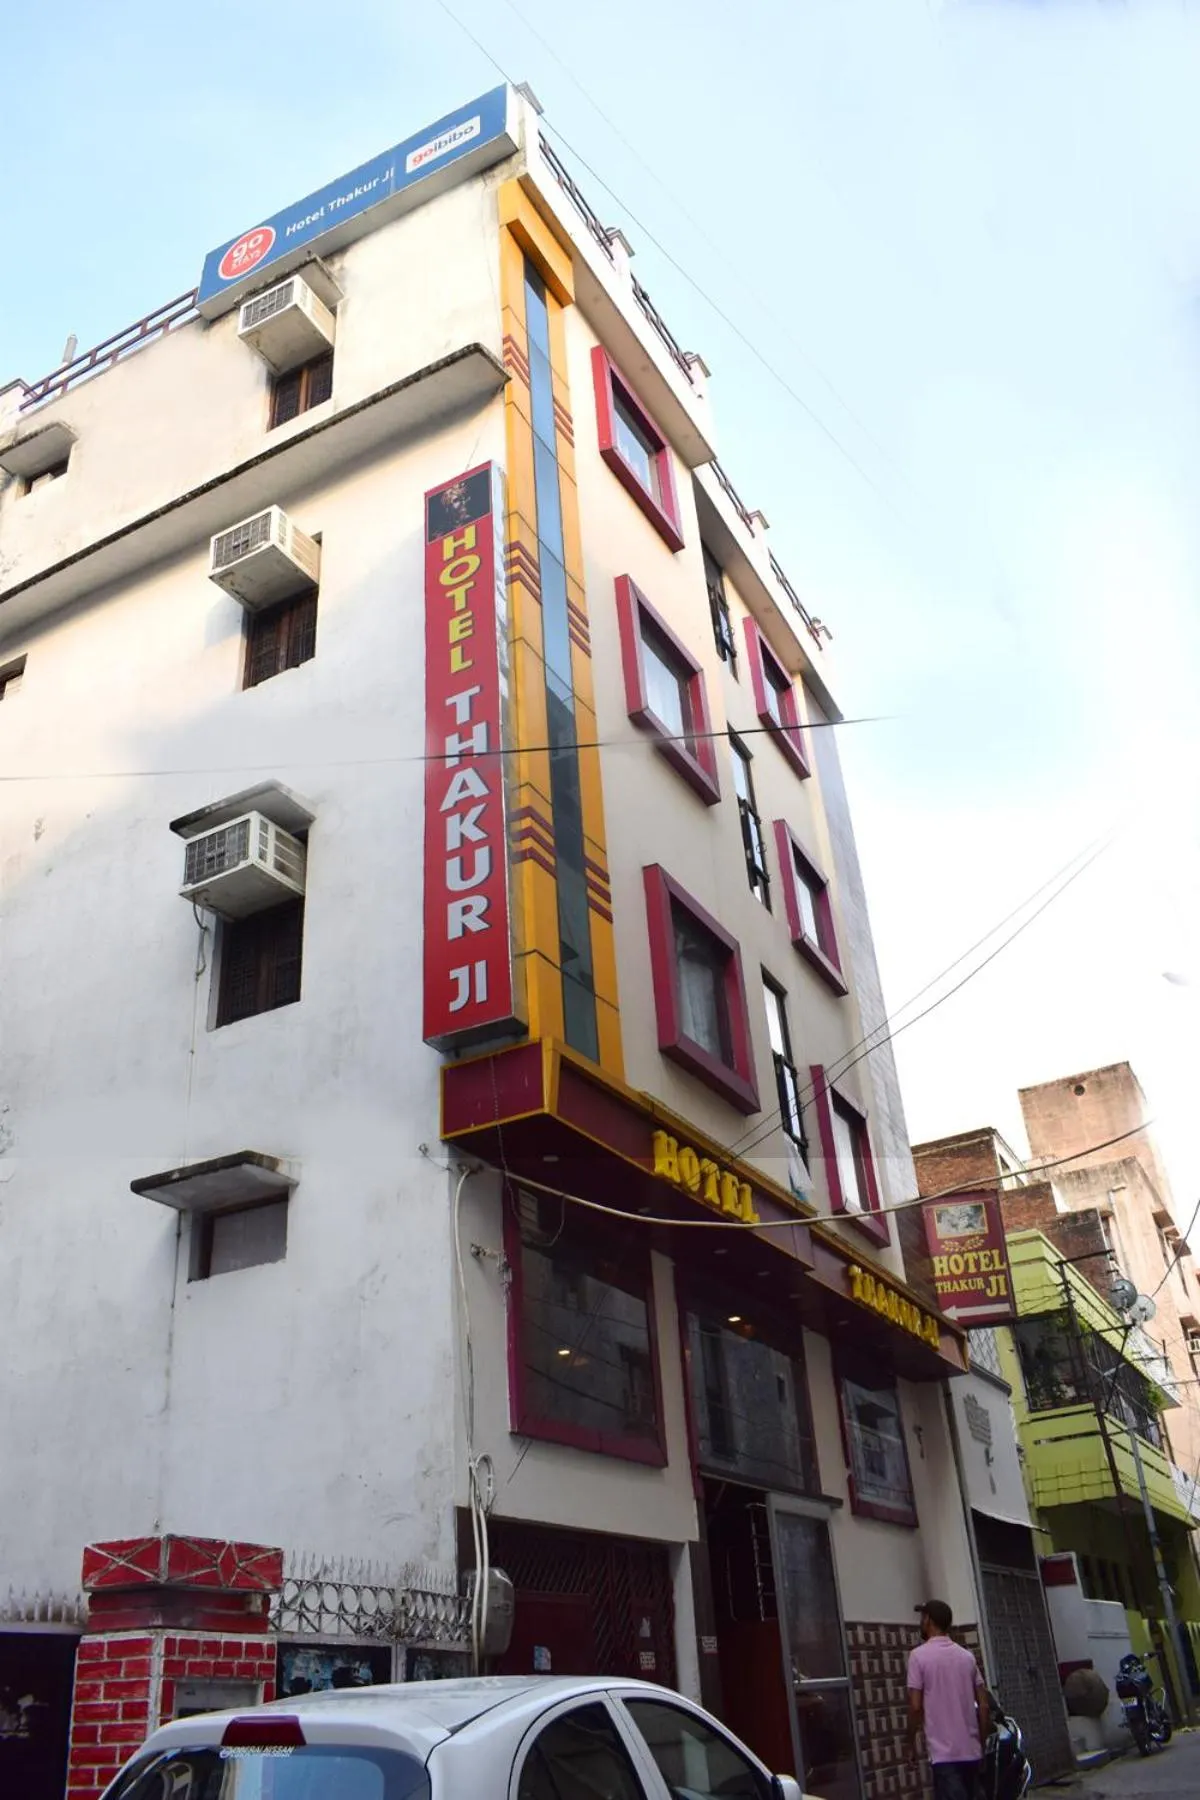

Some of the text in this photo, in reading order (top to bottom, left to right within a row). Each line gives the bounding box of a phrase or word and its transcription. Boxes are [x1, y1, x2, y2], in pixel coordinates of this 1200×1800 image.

[412, 126, 474, 167] goibibo
[286, 206, 324, 236] Hotel
[328, 177, 380, 211] Thakur
[232, 234, 264, 266] go
[439, 524, 490, 1013] HOTEL THAKUR JI
[652, 1130, 760, 1224] HOTEL
[932, 1249, 1006, 1277] HOTEL
[936, 1274, 1007, 1297] THAKUR JI
